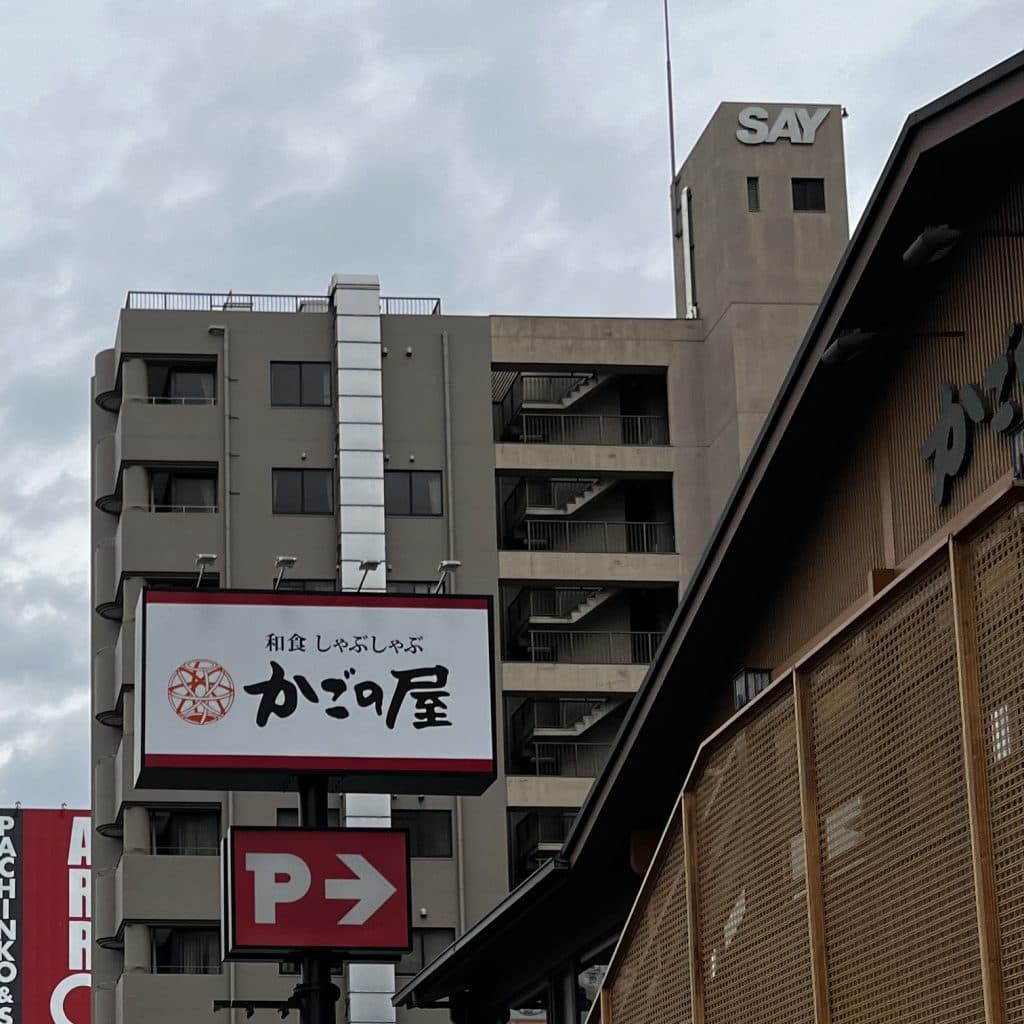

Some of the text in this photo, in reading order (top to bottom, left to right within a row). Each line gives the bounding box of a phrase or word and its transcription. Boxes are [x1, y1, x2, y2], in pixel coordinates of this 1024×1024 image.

[736, 106, 831, 144] SAY
[265, 633, 424, 654] 和食 しゃぶしゃぶ
[244, 660, 453, 729] かごの屋
[245, 853, 312, 925] P
